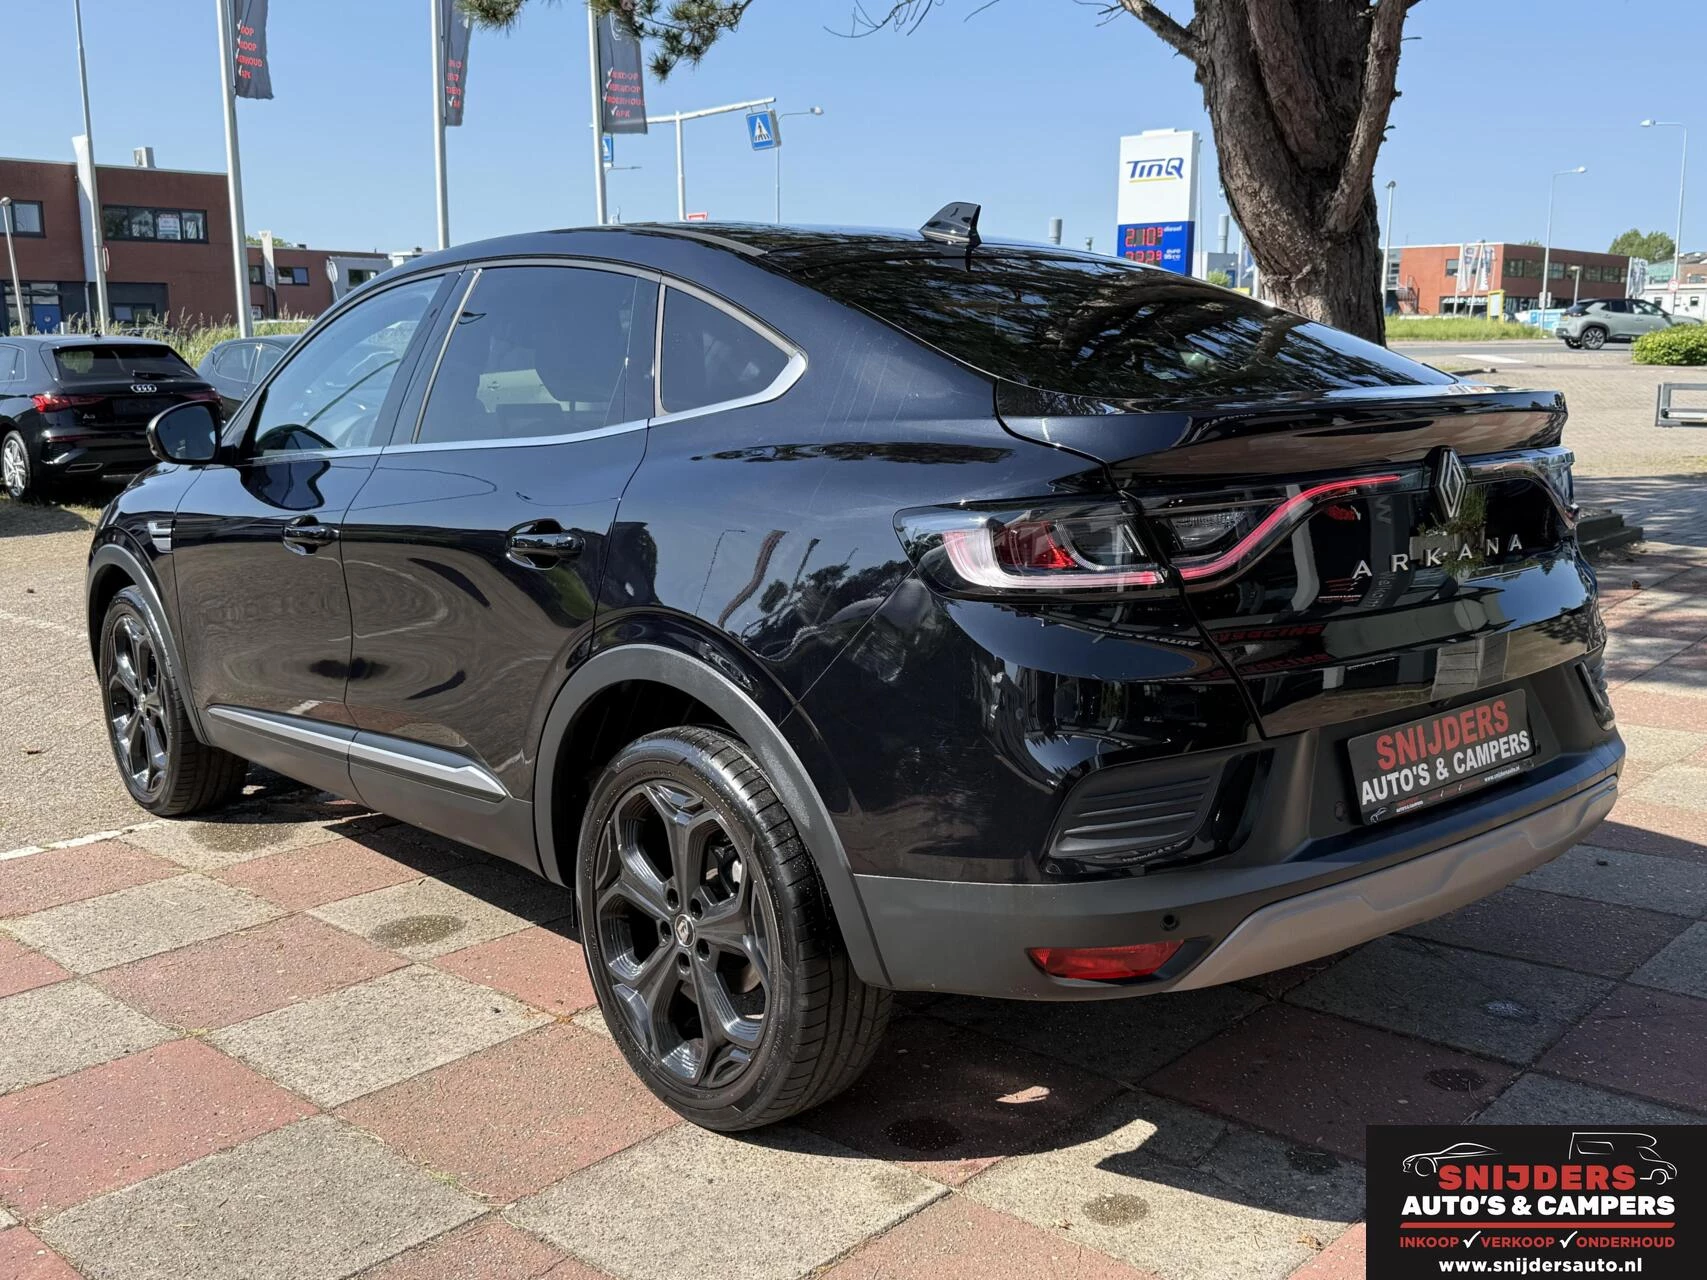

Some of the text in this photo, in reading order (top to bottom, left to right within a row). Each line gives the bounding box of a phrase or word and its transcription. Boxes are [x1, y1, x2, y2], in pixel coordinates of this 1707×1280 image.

[1352, 534, 1522, 579] ARKANA
[1361, 763, 1431, 806] AUTO'S
[1435, 757, 1450, 781] &
[1453, 730, 1531, 774] CAMPERS
[1376, 700, 1509, 770] SNIJDERS
